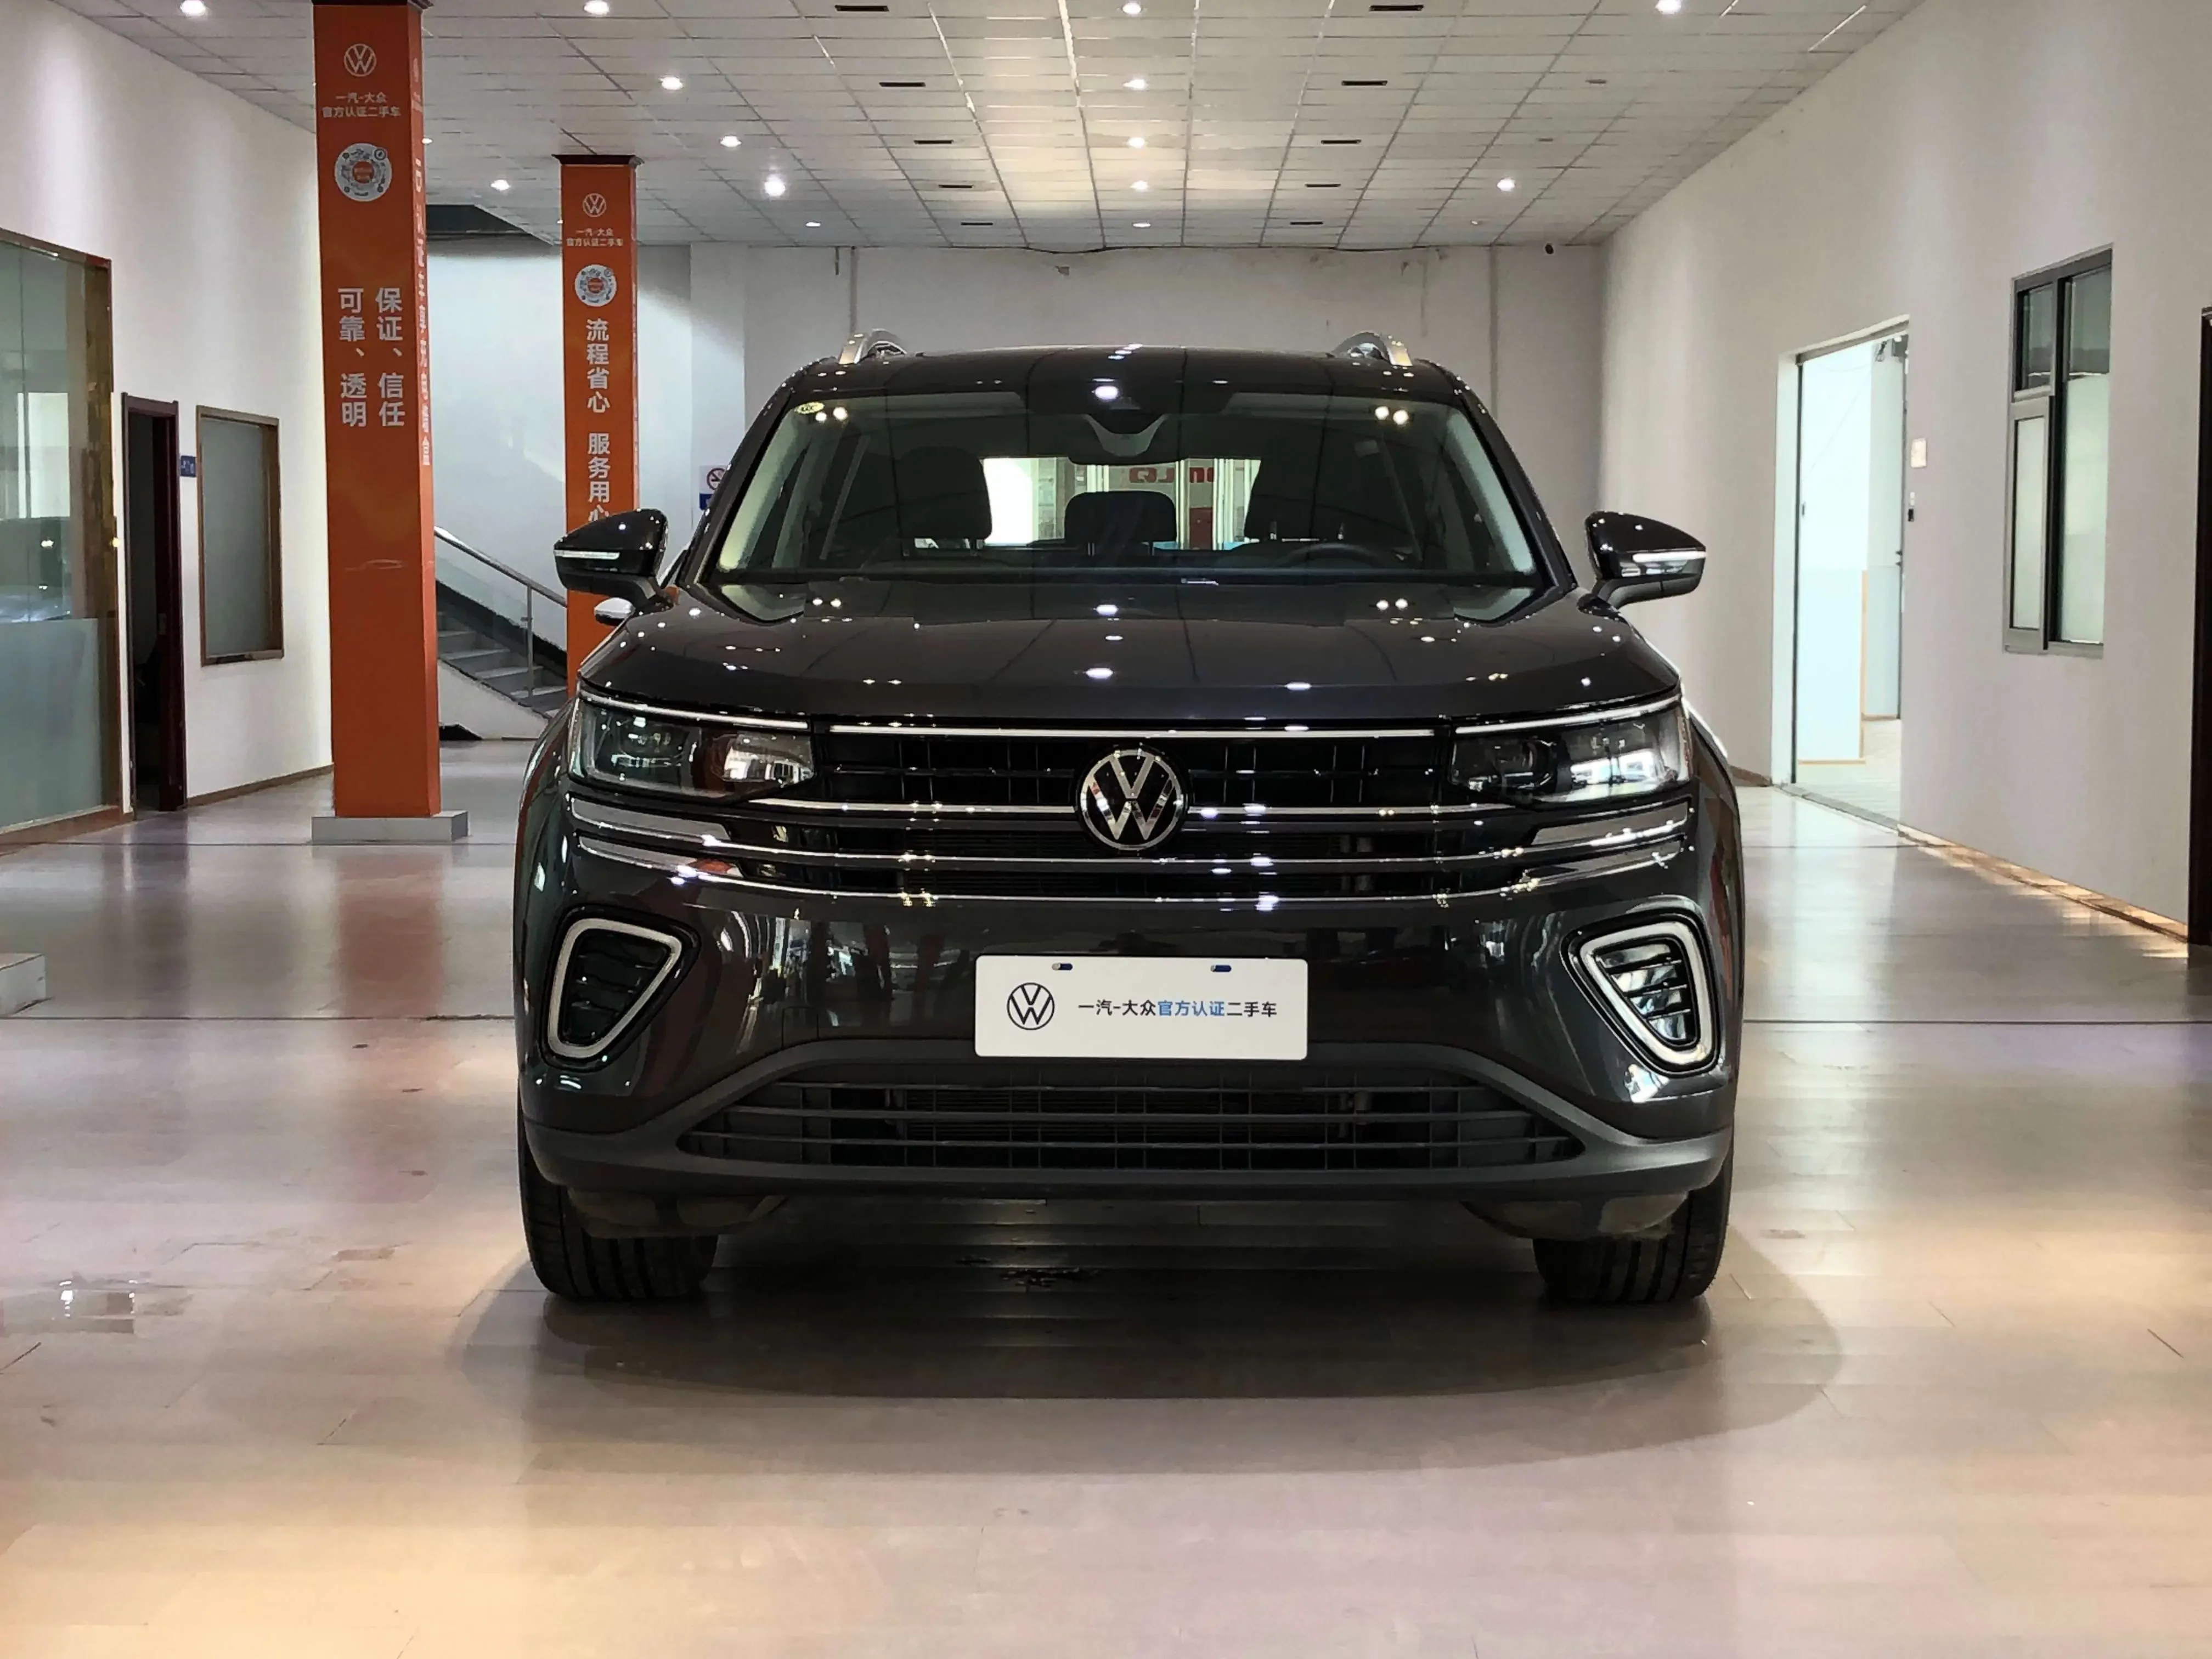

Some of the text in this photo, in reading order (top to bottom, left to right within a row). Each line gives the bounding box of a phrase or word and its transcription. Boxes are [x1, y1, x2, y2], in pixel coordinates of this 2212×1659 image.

[322, 106, 401, 117] 官方认证二手车
[335, 92, 387, 104] 一汽-大众
[337, 287, 367, 427] 可靠、透明
[375, 287, 405, 427] 保证、信任
[585, 318, 610, 413] 流程省心
[1077, 999, 1278, 1018] 一汽-大众官方认证二手车
